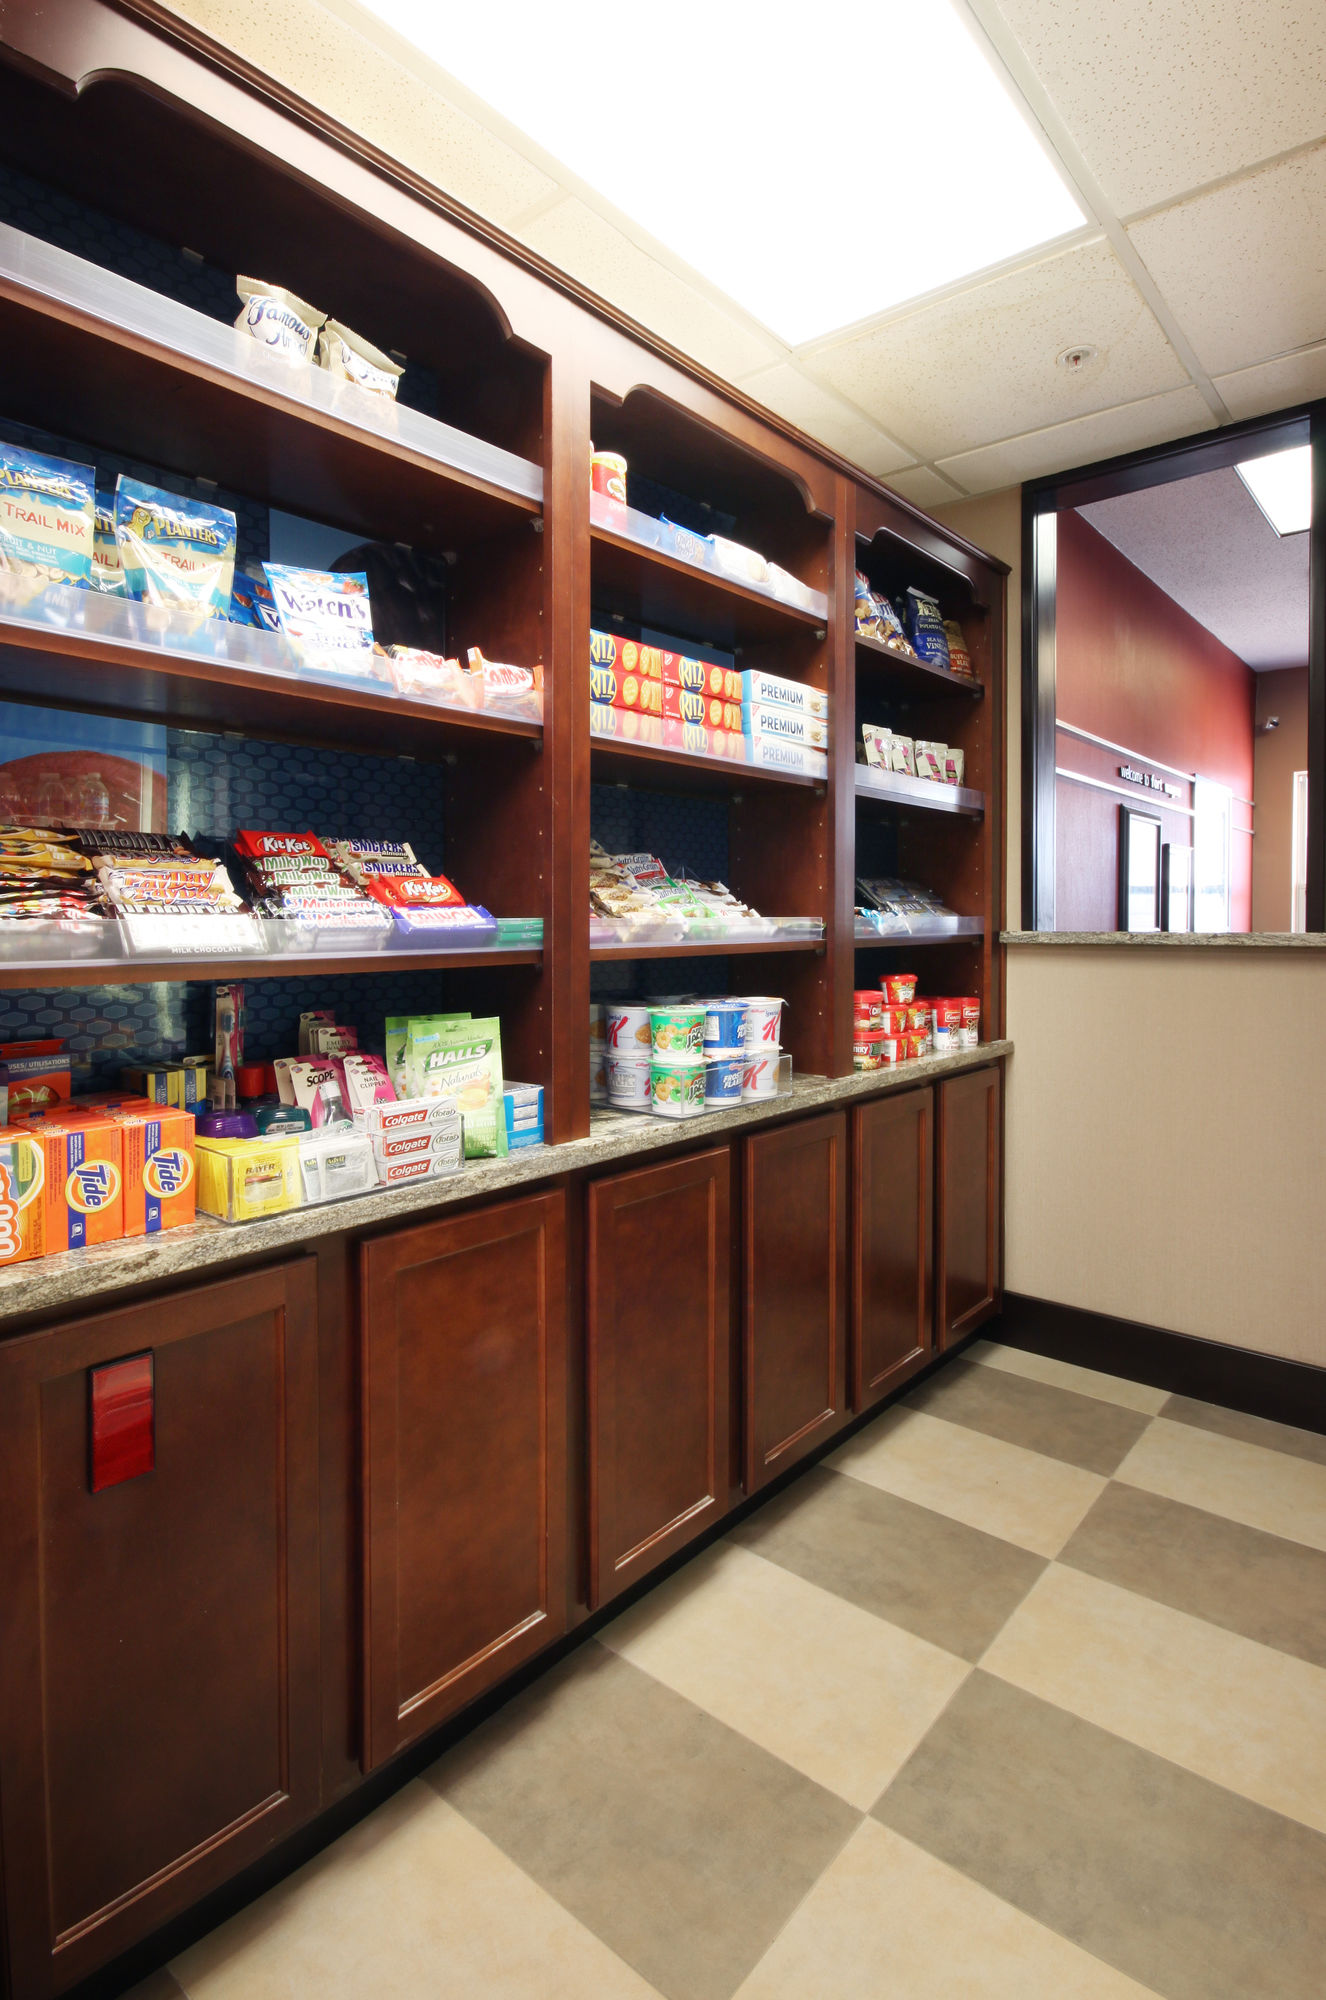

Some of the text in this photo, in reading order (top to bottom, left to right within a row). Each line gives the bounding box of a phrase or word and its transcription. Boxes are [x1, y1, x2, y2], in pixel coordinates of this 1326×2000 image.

[247, 297, 311, 341] Famous
[4, 501, 53, 529] TRAIL
[56, 518, 86, 538] MIX
[153, 517, 218, 545] PLANTERS
[682, 657, 705, 689] RITZ
[761, 683, 804, 705] PREMIUM
[682, 690, 705, 721] RITZ
[761, 715, 804, 736] PREMIUM
[763, 746, 804, 766] PREMIUM
[1120, 765, 1144, 785] welcome
[1144, 773, 1150, 787] to
[1151, 774, 1163, 791] fort
[302, 899, 371, 909] Musketeers
[170, 945, 243, 954] MILK CHOCOLATE
[762, 1008, 781, 1042] K
[29, 1058, 70, 1068] UTILISATIONS
[429, 1044, 487, 1069] HALLS
[306, 1070, 334, 1087] SCOPE
[360, 1081, 387, 1089] CLIPPER
[742, 1060, 768, 1091] K
[385, 1112, 424, 1127] Colgate
[388, 1138, 428, 1153] Colgate
[152, 1151, 181, 1193] Tide
[246, 1163, 275, 1175] BAYER
[389, 1162, 428, 1177] Colgate
[75, 1164, 108, 1208] Tide
